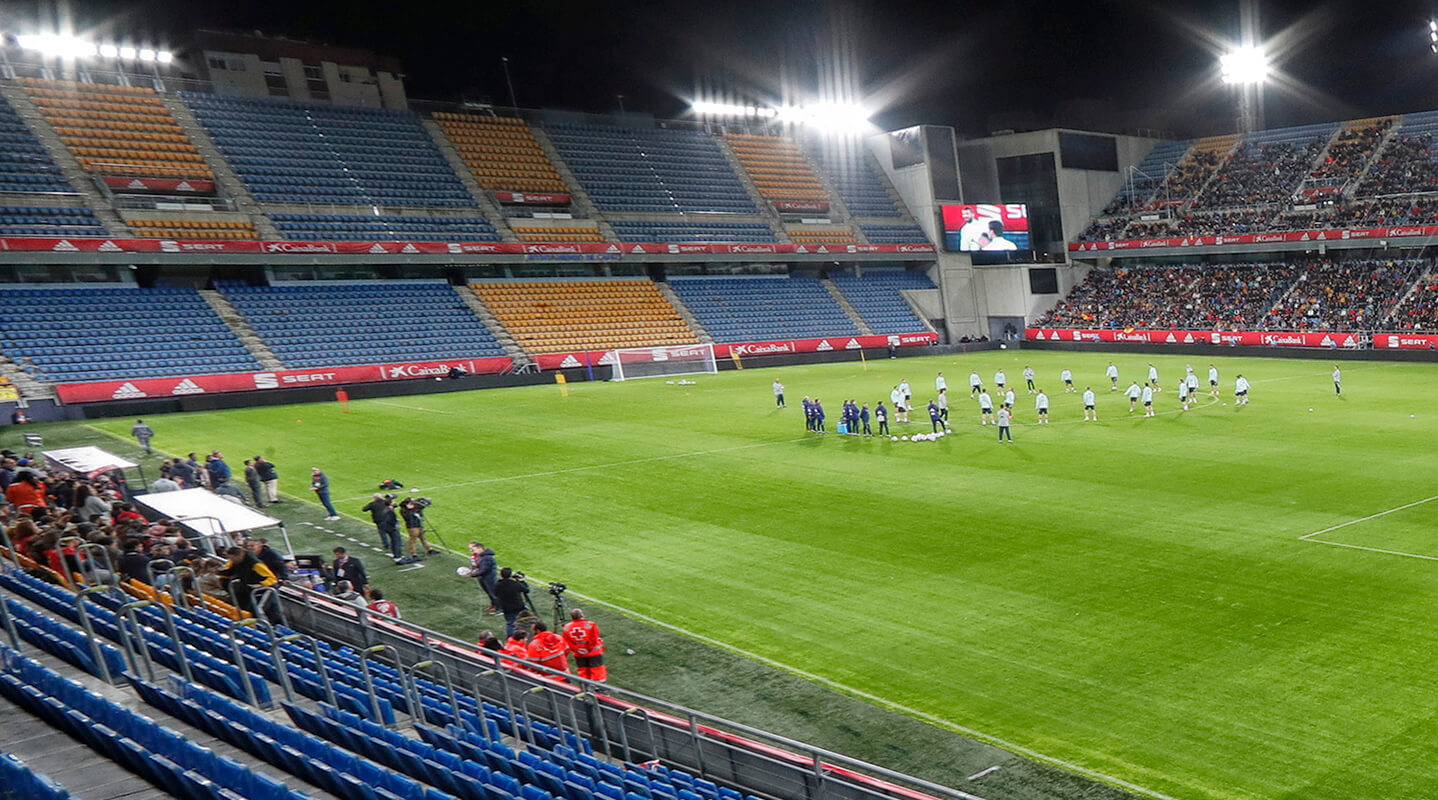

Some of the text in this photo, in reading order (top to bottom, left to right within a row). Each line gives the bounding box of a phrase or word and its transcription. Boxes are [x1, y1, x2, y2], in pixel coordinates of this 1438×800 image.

[901, 335, 930, 343] SEAT
[749, 343, 790, 355] CaixaBank
[282, 372, 336, 384] SEAT
